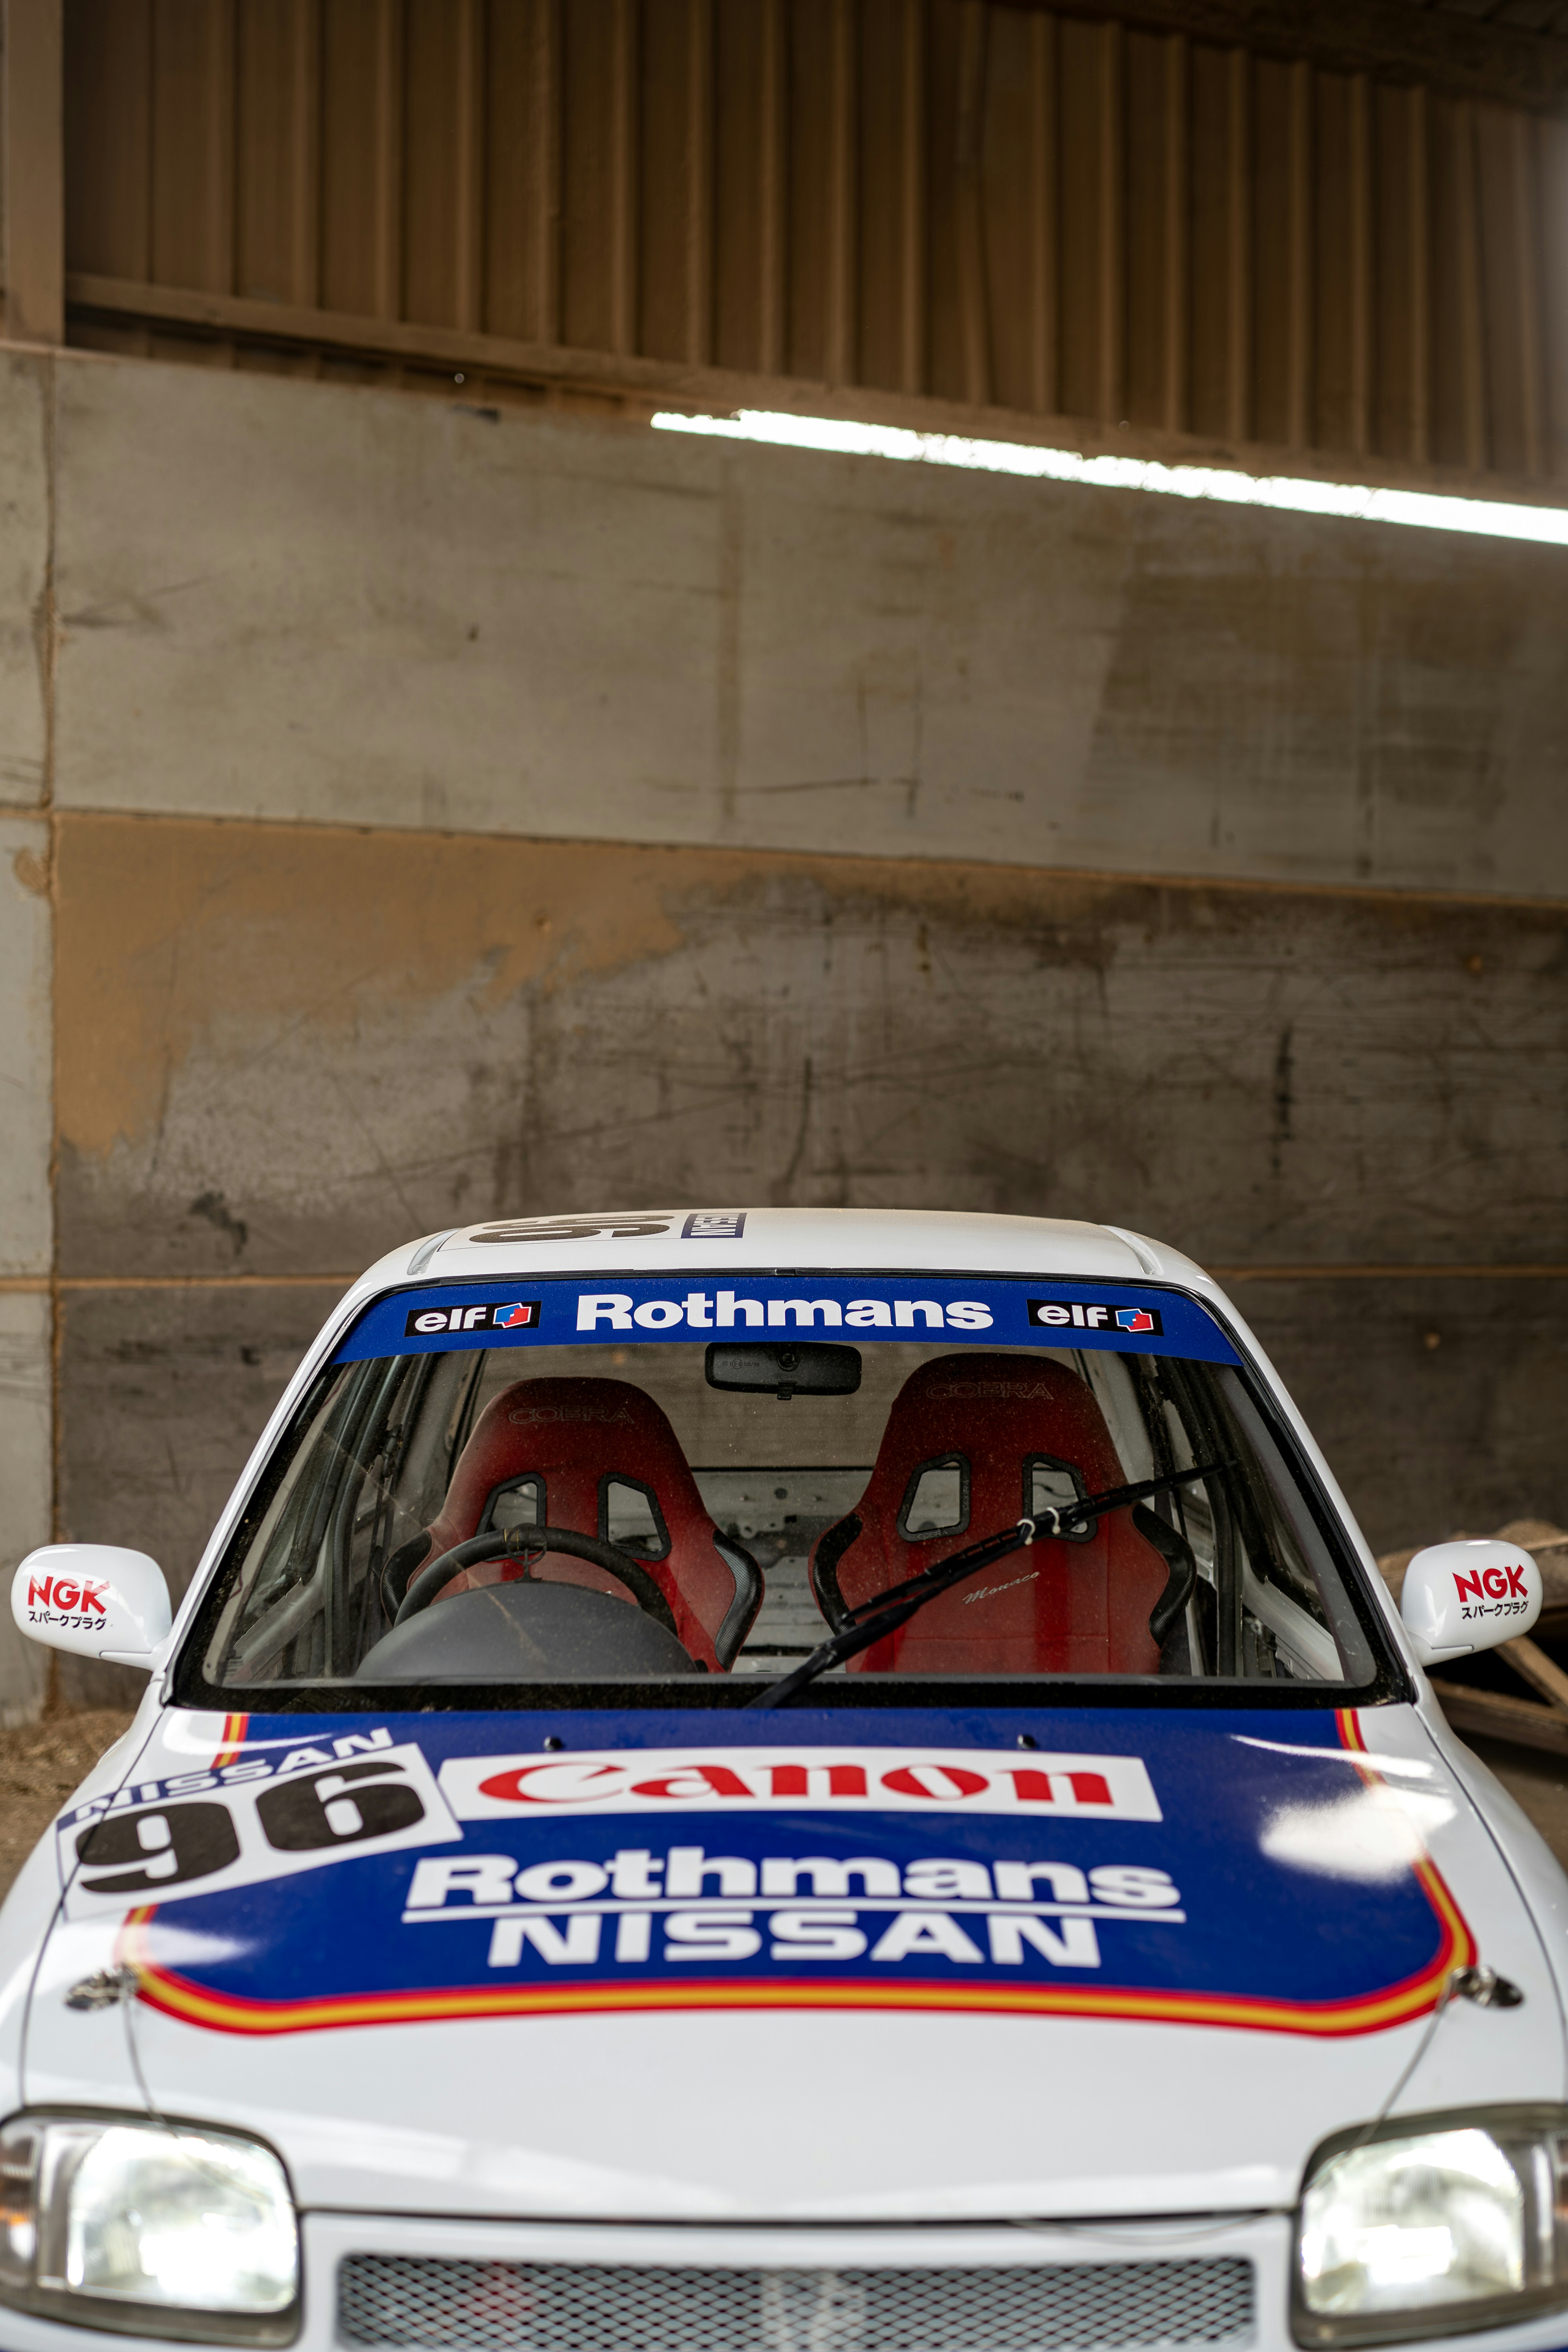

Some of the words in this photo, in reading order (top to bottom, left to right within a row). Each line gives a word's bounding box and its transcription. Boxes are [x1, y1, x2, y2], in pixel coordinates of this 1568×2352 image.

[415, 1307, 487, 1332] elf
[576, 1291, 994, 1331] Rothmans
[1037, 1305, 1108, 1328] elf
[926, 1382, 1054, 1400] COBRA
[509, 1405, 636, 1425] COBRA
[917, 1529, 948, 1539] COBRA
[28, 1574, 110, 1615] NGK
[962, 1571, 1040, 1604] Monaco
[1452, 1564, 1529, 1603] NGK
[28, 1610, 107, 1631] スパークプラグ
[1462, 1600, 1529, 1620] スパークプラグ
[75, 1726, 393, 1821] NISSAN
[476, 1761, 1115, 1807] Canon
[75, 1761, 426, 1894] 96
[408, 1845, 1182, 1910] Rothmans
[487, 1910, 1102, 1969] NISSAN
